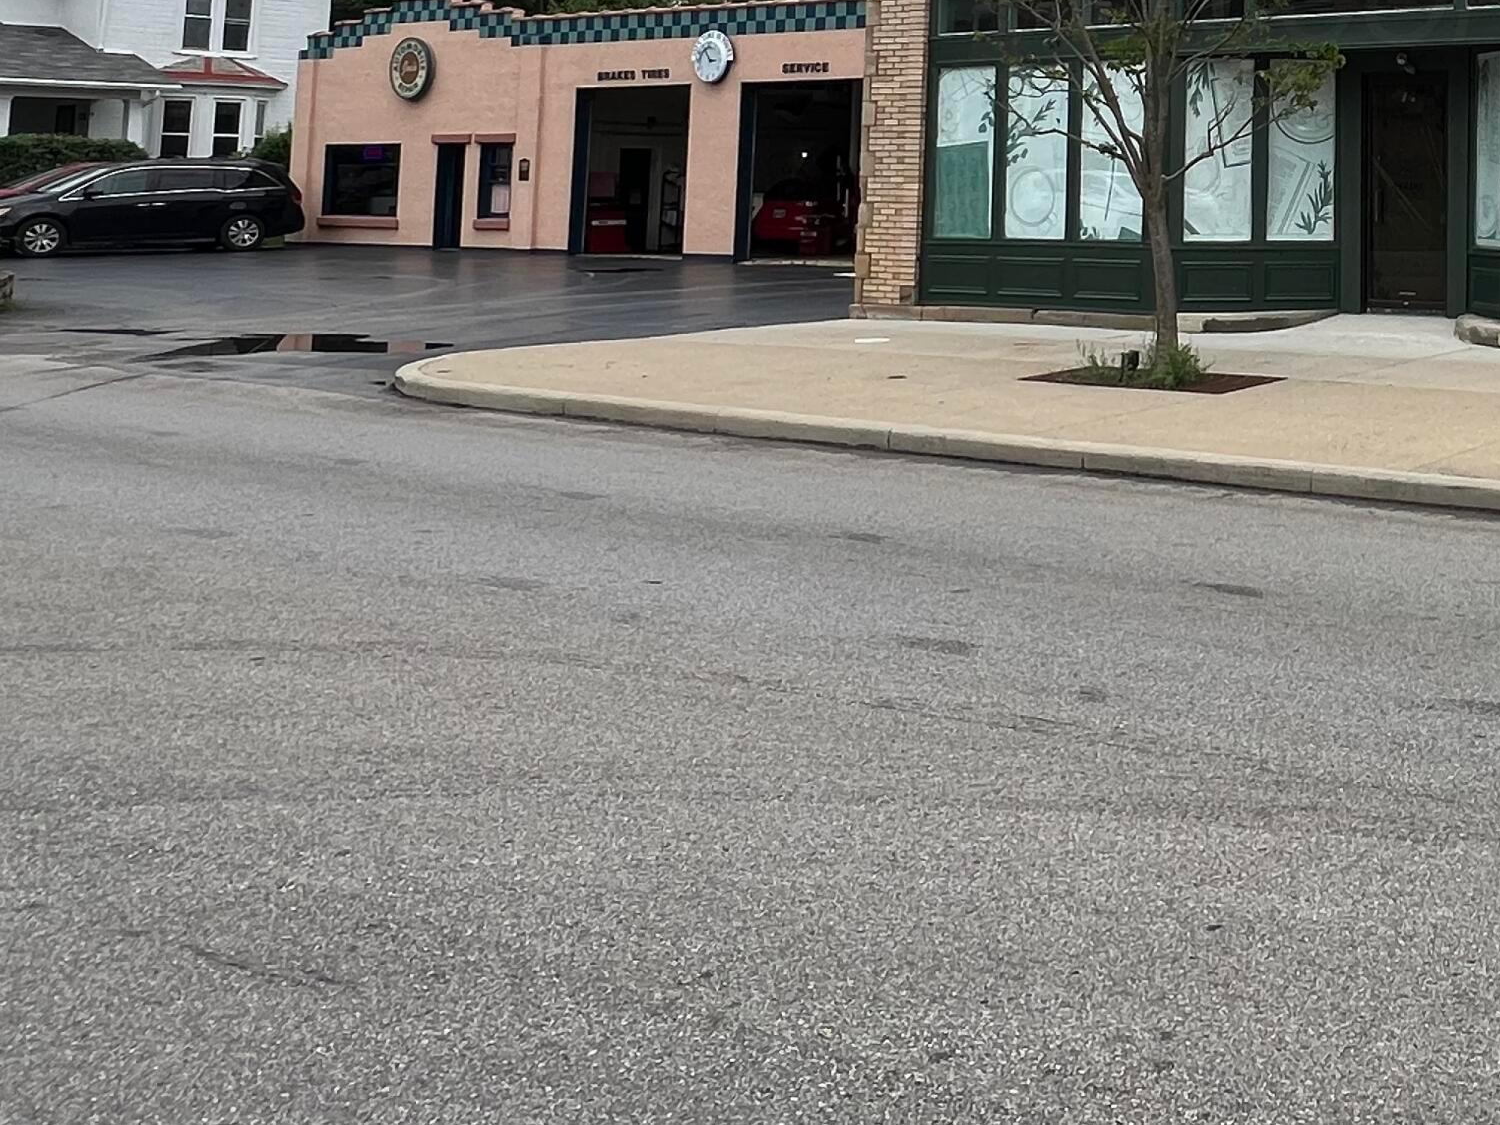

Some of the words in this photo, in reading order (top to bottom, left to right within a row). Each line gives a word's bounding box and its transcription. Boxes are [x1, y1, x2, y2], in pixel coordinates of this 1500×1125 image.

[782, 62, 829, 74] SERVICE
[597, 70, 636, 82] BRAKES
[640, 68, 670, 80] TIRES
